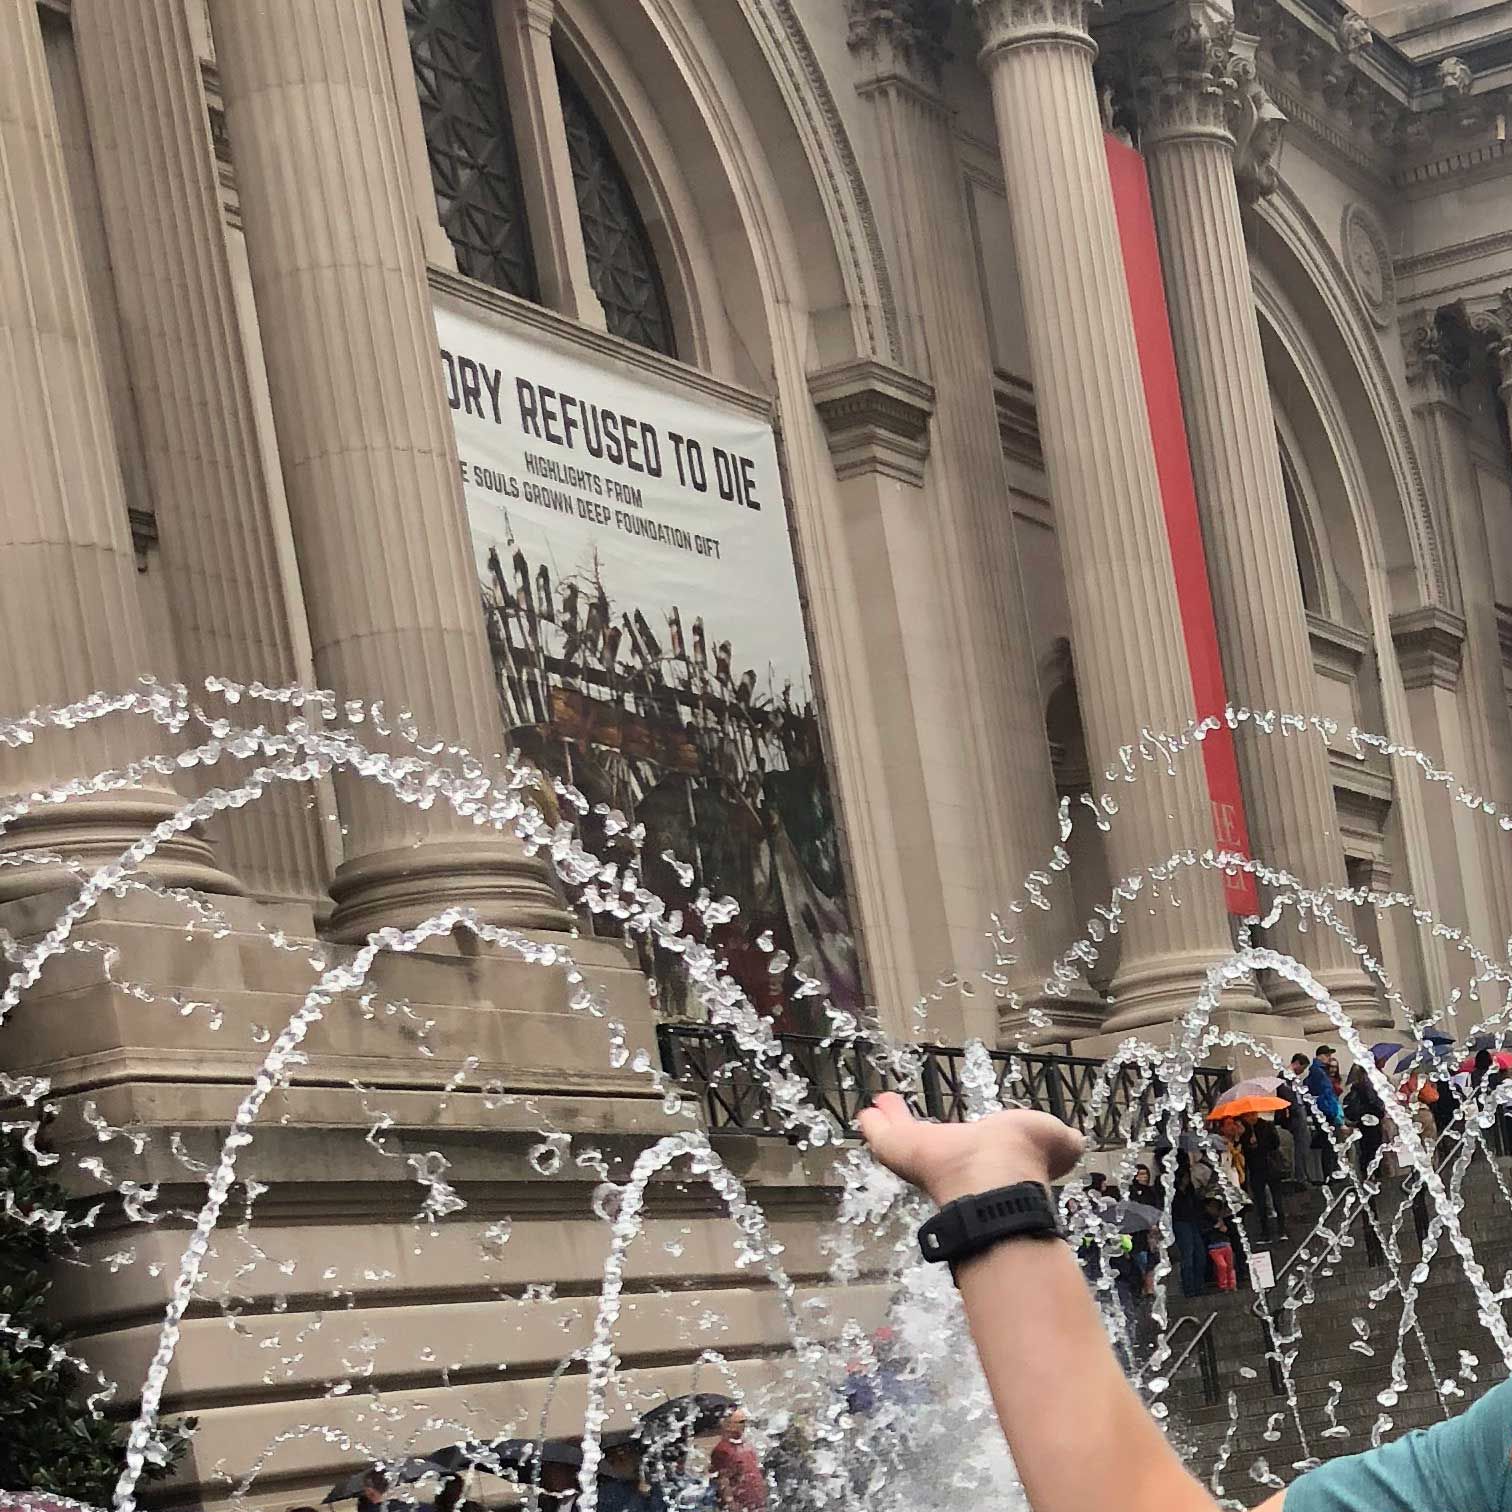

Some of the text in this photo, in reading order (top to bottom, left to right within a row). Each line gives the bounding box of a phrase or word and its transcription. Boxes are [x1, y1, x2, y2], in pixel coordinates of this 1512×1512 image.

[516, 377, 662, 478] REFUSED
[668, 431, 708, 493] TO
[712, 447, 761, 511] DIE
[524, 451, 643, 508] HIGHLIGHTS FROM
[474, 465, 519, 498] SOULS
[523, 481, 574, 515] GROWN
[576, 497, 611, 525] DEEP
[614, 510, 692, 551] FOUNDATION
[694, 534, 721, 559] GIFT
